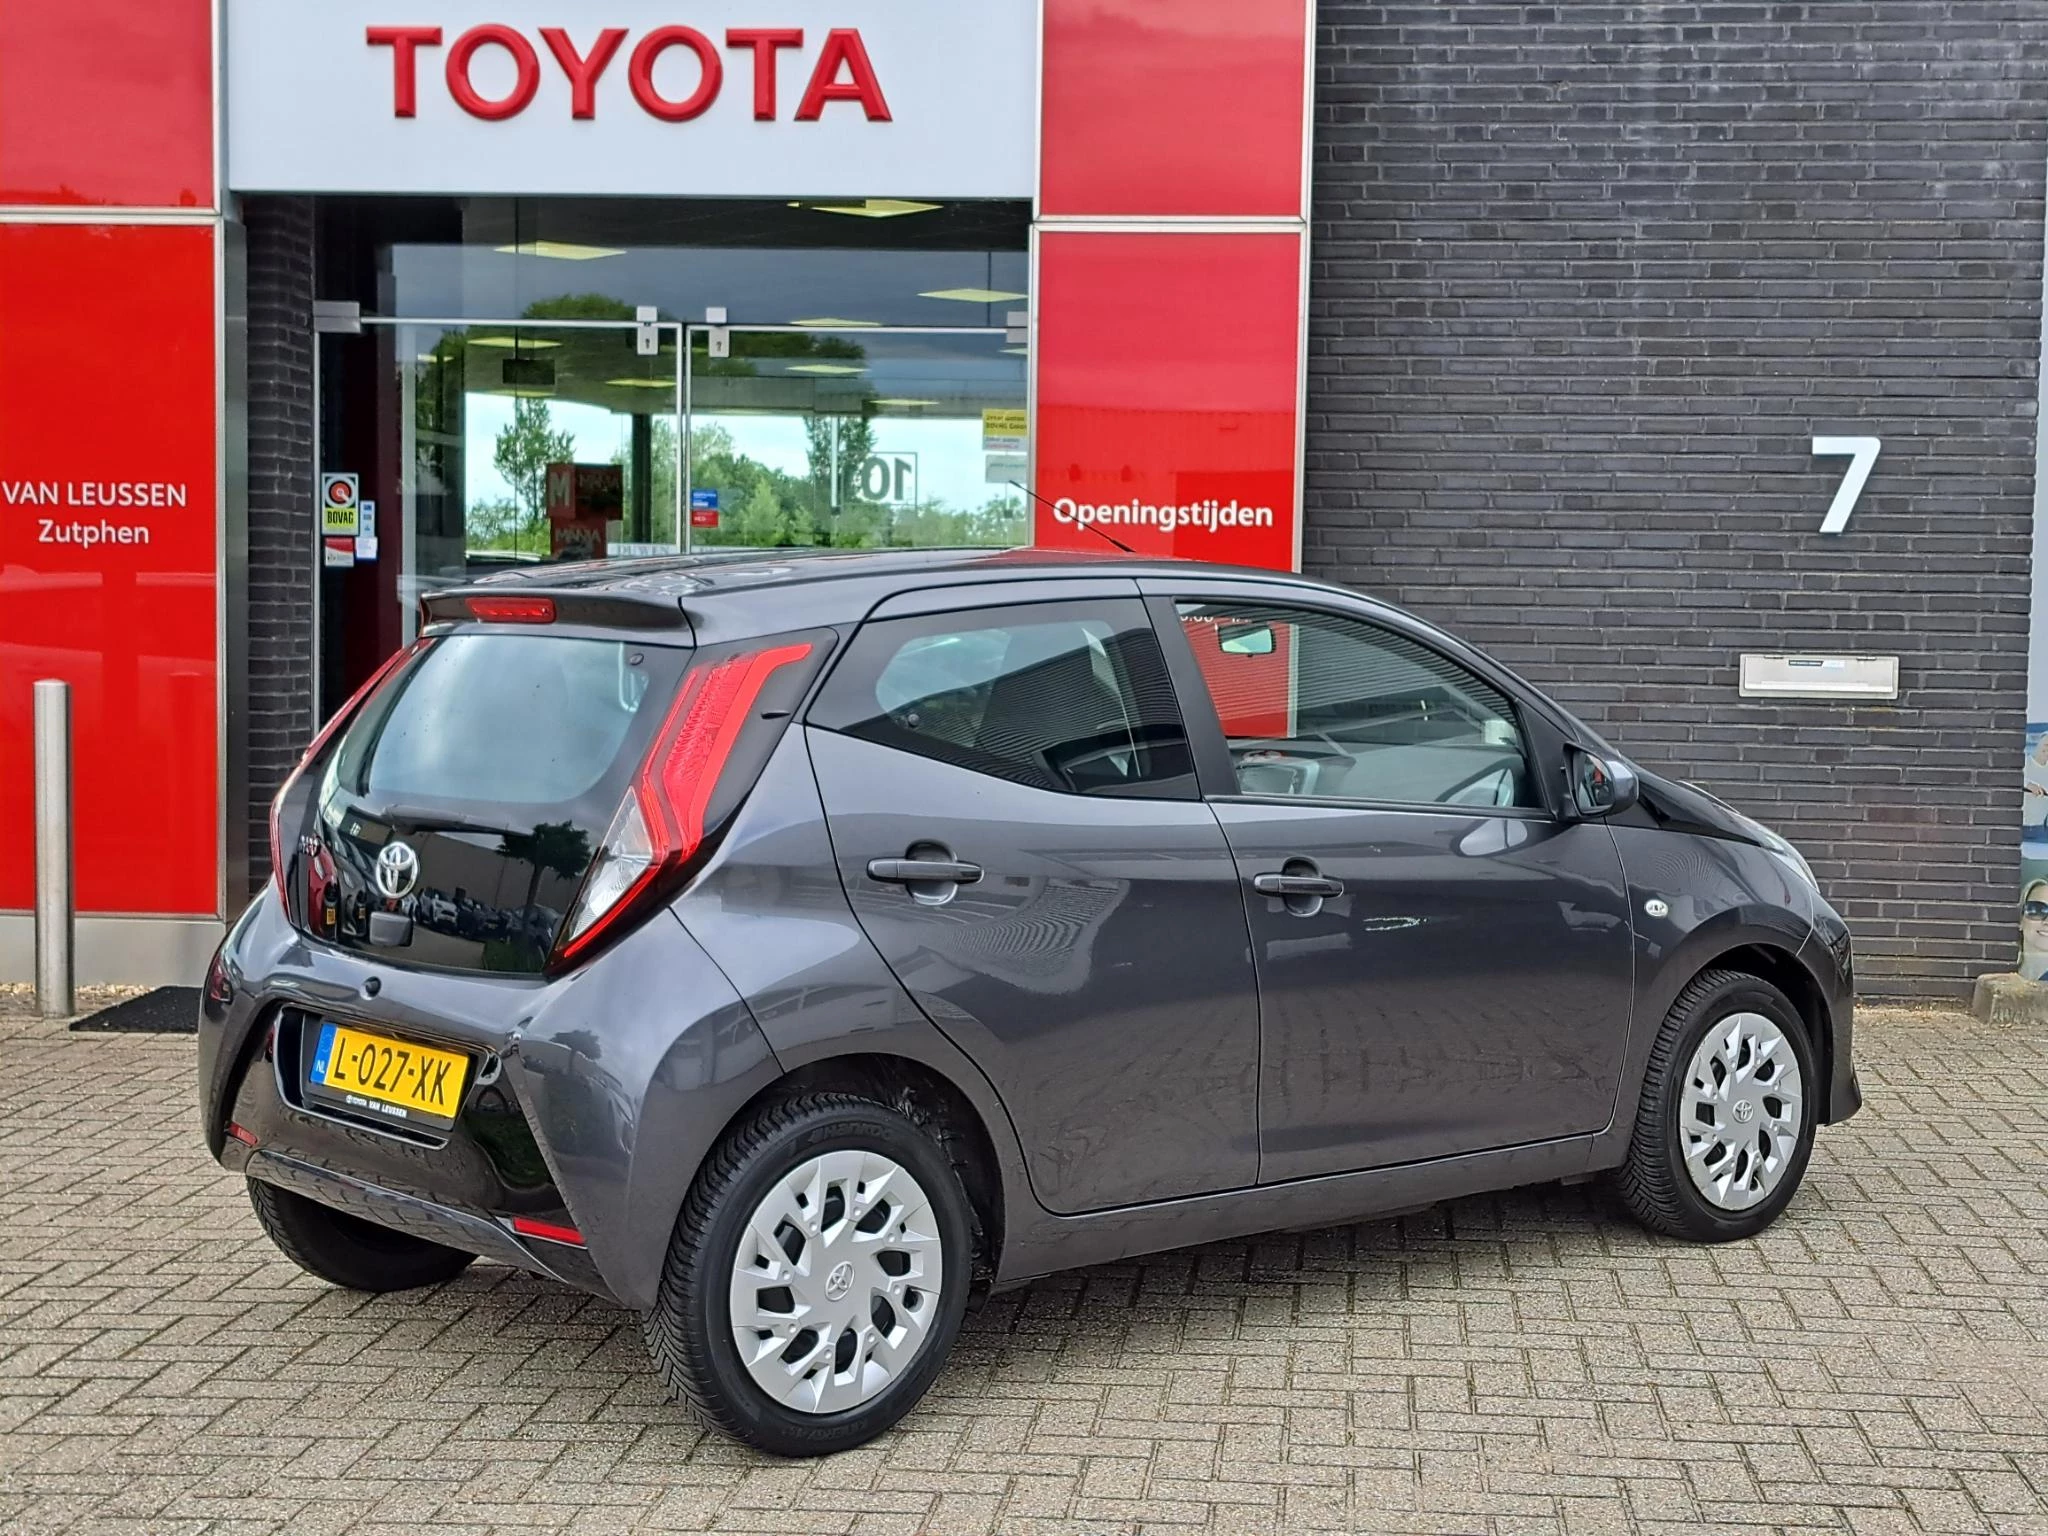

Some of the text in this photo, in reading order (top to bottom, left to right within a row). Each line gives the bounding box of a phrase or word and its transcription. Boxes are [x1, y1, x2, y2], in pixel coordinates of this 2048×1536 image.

[366, 23, 893, 123] TOYOTA
[2, 481, 187, 508] VAN LEUSSEN
[550, 471, 570, 507] M
[1812, 436, 1881, 533] 7
[327, 511, 354, 524] BOVAG
[1053, 498, 1273, 533] Openingstijden
[38, 519, 149, 549] Zutphen
[315, 1060, 325, 1074] NL
[333, 1037, 452, 1105] L-027-XK
[368, 1099, 381, 1111] VAN
[381, 1103, 408, 1119] LEUSSEN
